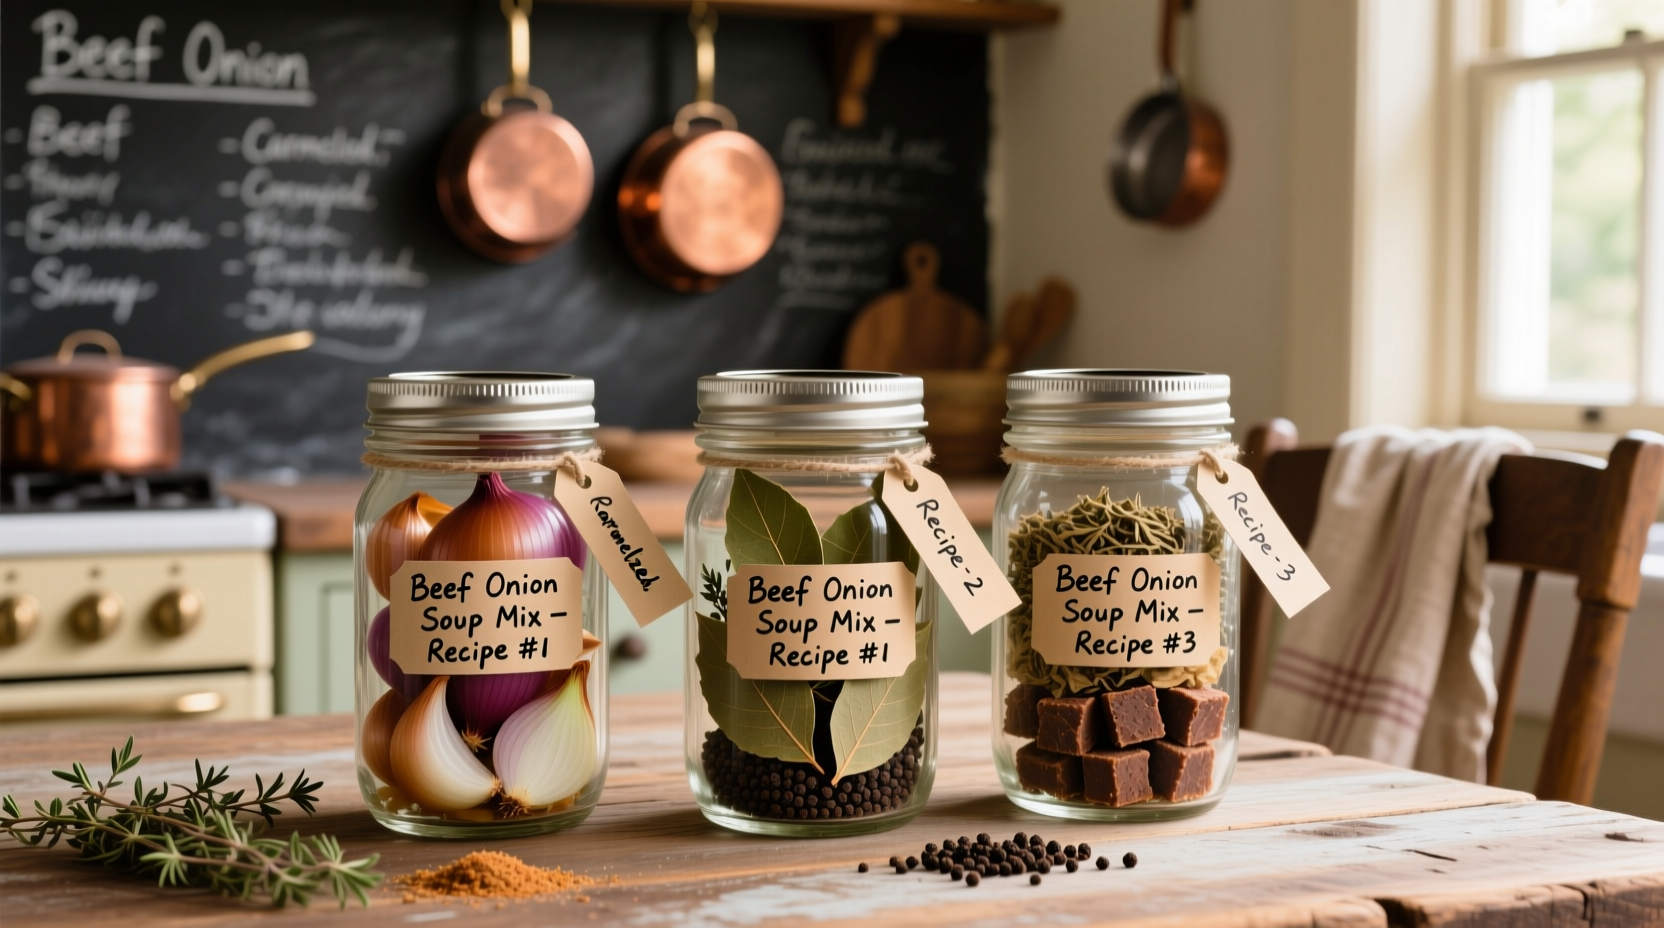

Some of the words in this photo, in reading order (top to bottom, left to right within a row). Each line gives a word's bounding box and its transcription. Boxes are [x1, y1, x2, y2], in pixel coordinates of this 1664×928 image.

[31, 9, 166, 82] Beef
[181, 20, 309, 88] Onion
[411, 572, 474, 603] Beef
[486, 572, 558, 597] Onion
[748, 576, 812, 607] Beef
[823, 576, 893, 602] Onion
[1056, 564, 1120, 595] Beef
[1131, 567, 1198, 592] Onion
[421, 606, 483, 638] Soup
[496, 605, 542, 628] Mix
[756, 609, 818, 644] Soup
[830, 609, 876, 633] Mix
[1062, 598, 1124, 632] Soup
[1135, 599, 1180, 623] Mix
[427, 638, 508, 670] Recipe
[519, 637, 548, 659] #1
[769, 641, 849, 674] Recipe
[859, 641, 888, 664] #1
[1075, 629, 1153, 663] Recipe
[1162, 631, 1197, 654] #3
